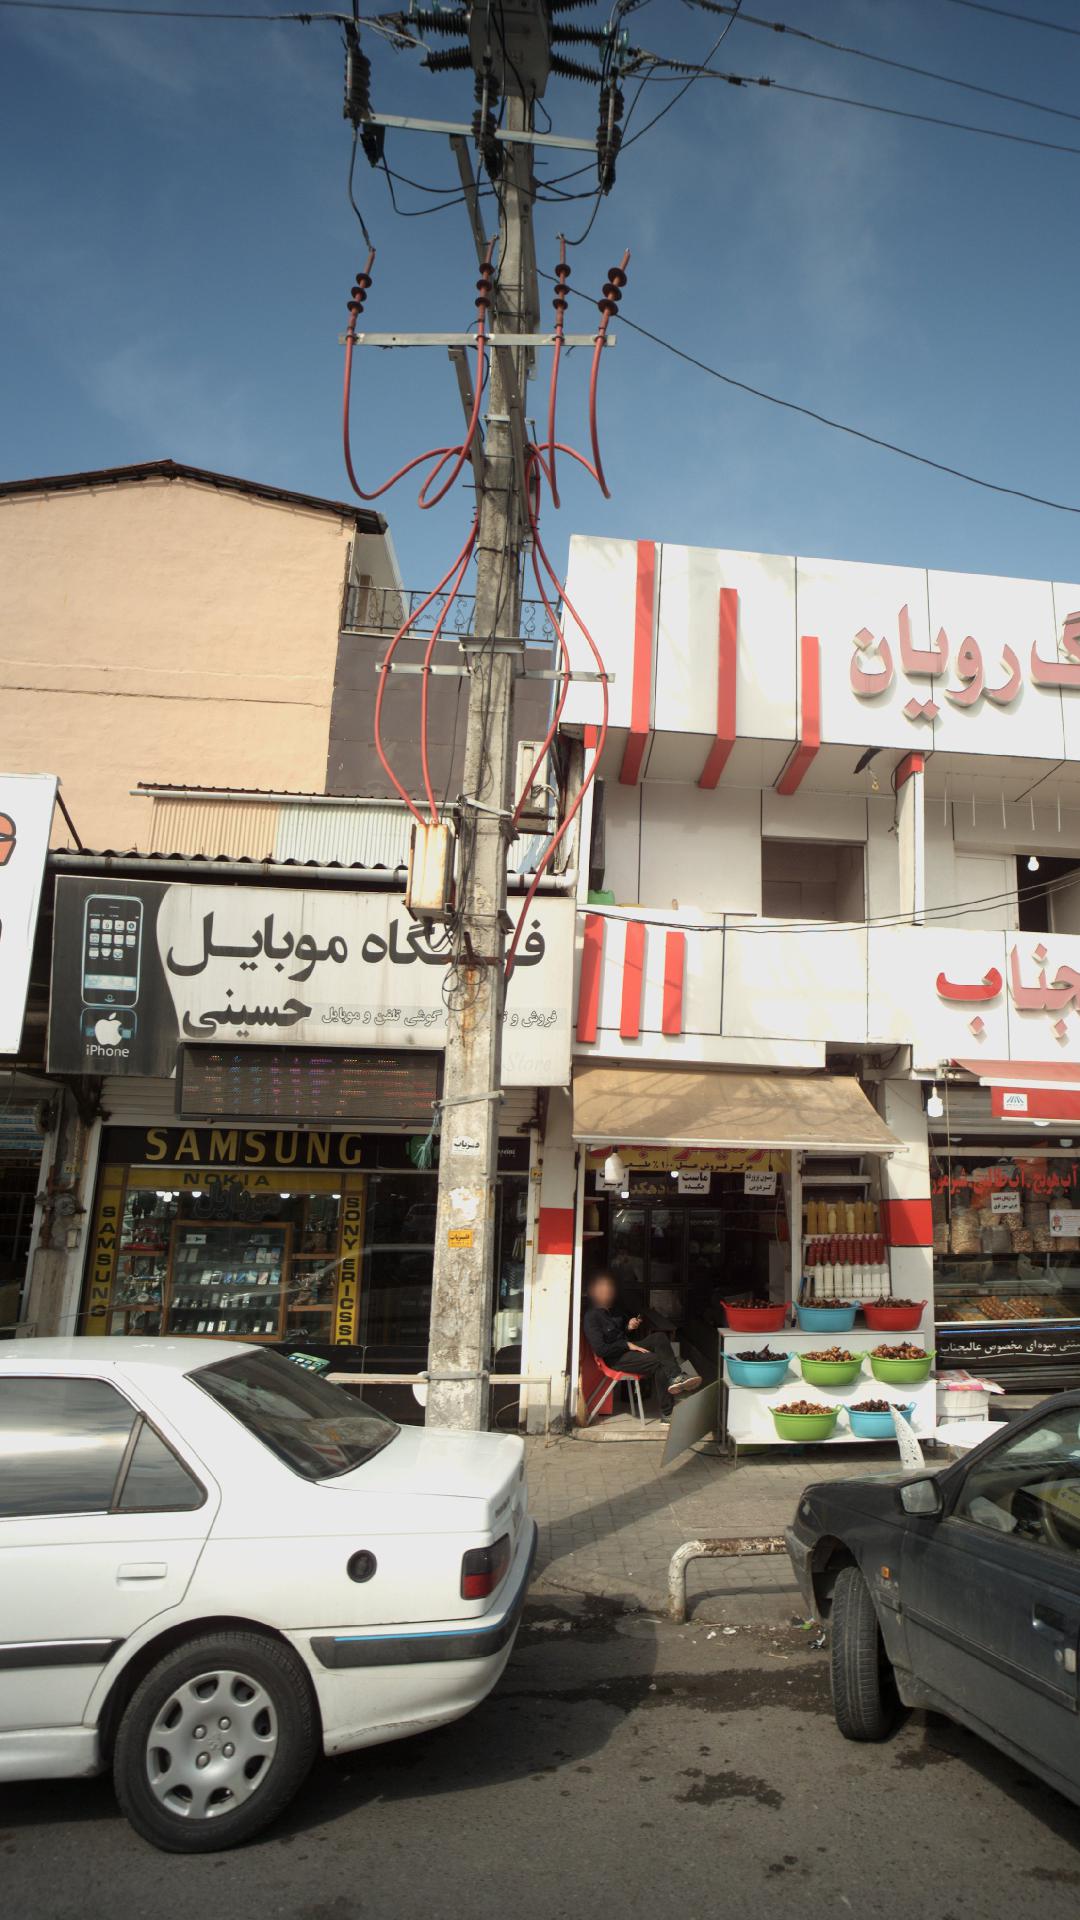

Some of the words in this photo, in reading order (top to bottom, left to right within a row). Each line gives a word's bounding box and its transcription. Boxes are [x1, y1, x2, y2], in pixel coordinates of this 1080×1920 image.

[850, 603, 1021, 721] رویان
[167, 911, 348, 982] موبایل
[183, 989, 312, 1038] حسینی
[322, 1006, 360, 1024] موبایل
[362, 1009, 372, 1024] و
[374, 1007, 401, 1026] تلفن
[404, 1008, 443, 1028] گوشی
[510, 1009, 520, 1026] و
[521, 1008, 558, 1028] فروش
[86, 1045, 130, 1058] iPhone
[145, 1127, 363, 1166] SAMSUNG
[184, 1172, 270, 1187] NOKIA
[682, 1171, 709, 1182] ماست
[343, 1198, 360, 1250] SONY
[90, 1206, 117, 1319] SAMSUNG
[940, 1342, 981, 1355] عالیجناب
[984, 1341, 1022, 1355] مخصوص
